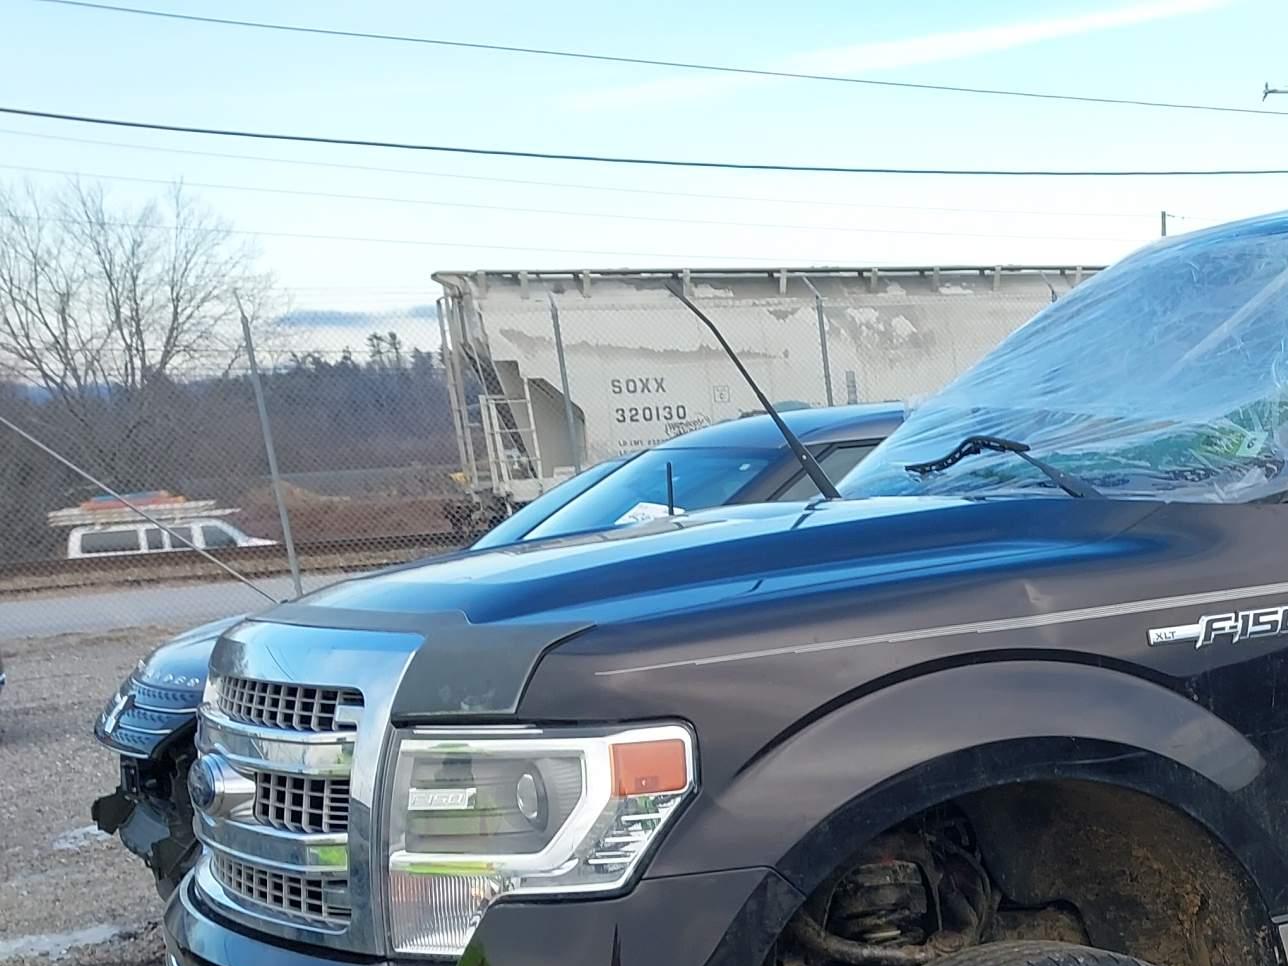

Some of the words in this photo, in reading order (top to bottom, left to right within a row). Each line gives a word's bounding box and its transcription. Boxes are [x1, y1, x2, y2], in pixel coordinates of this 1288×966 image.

[611, 377, 667, 395] SOXX
[615, 404, 688, 423] 320130
[1155, 630, 1177, 641] XLT
